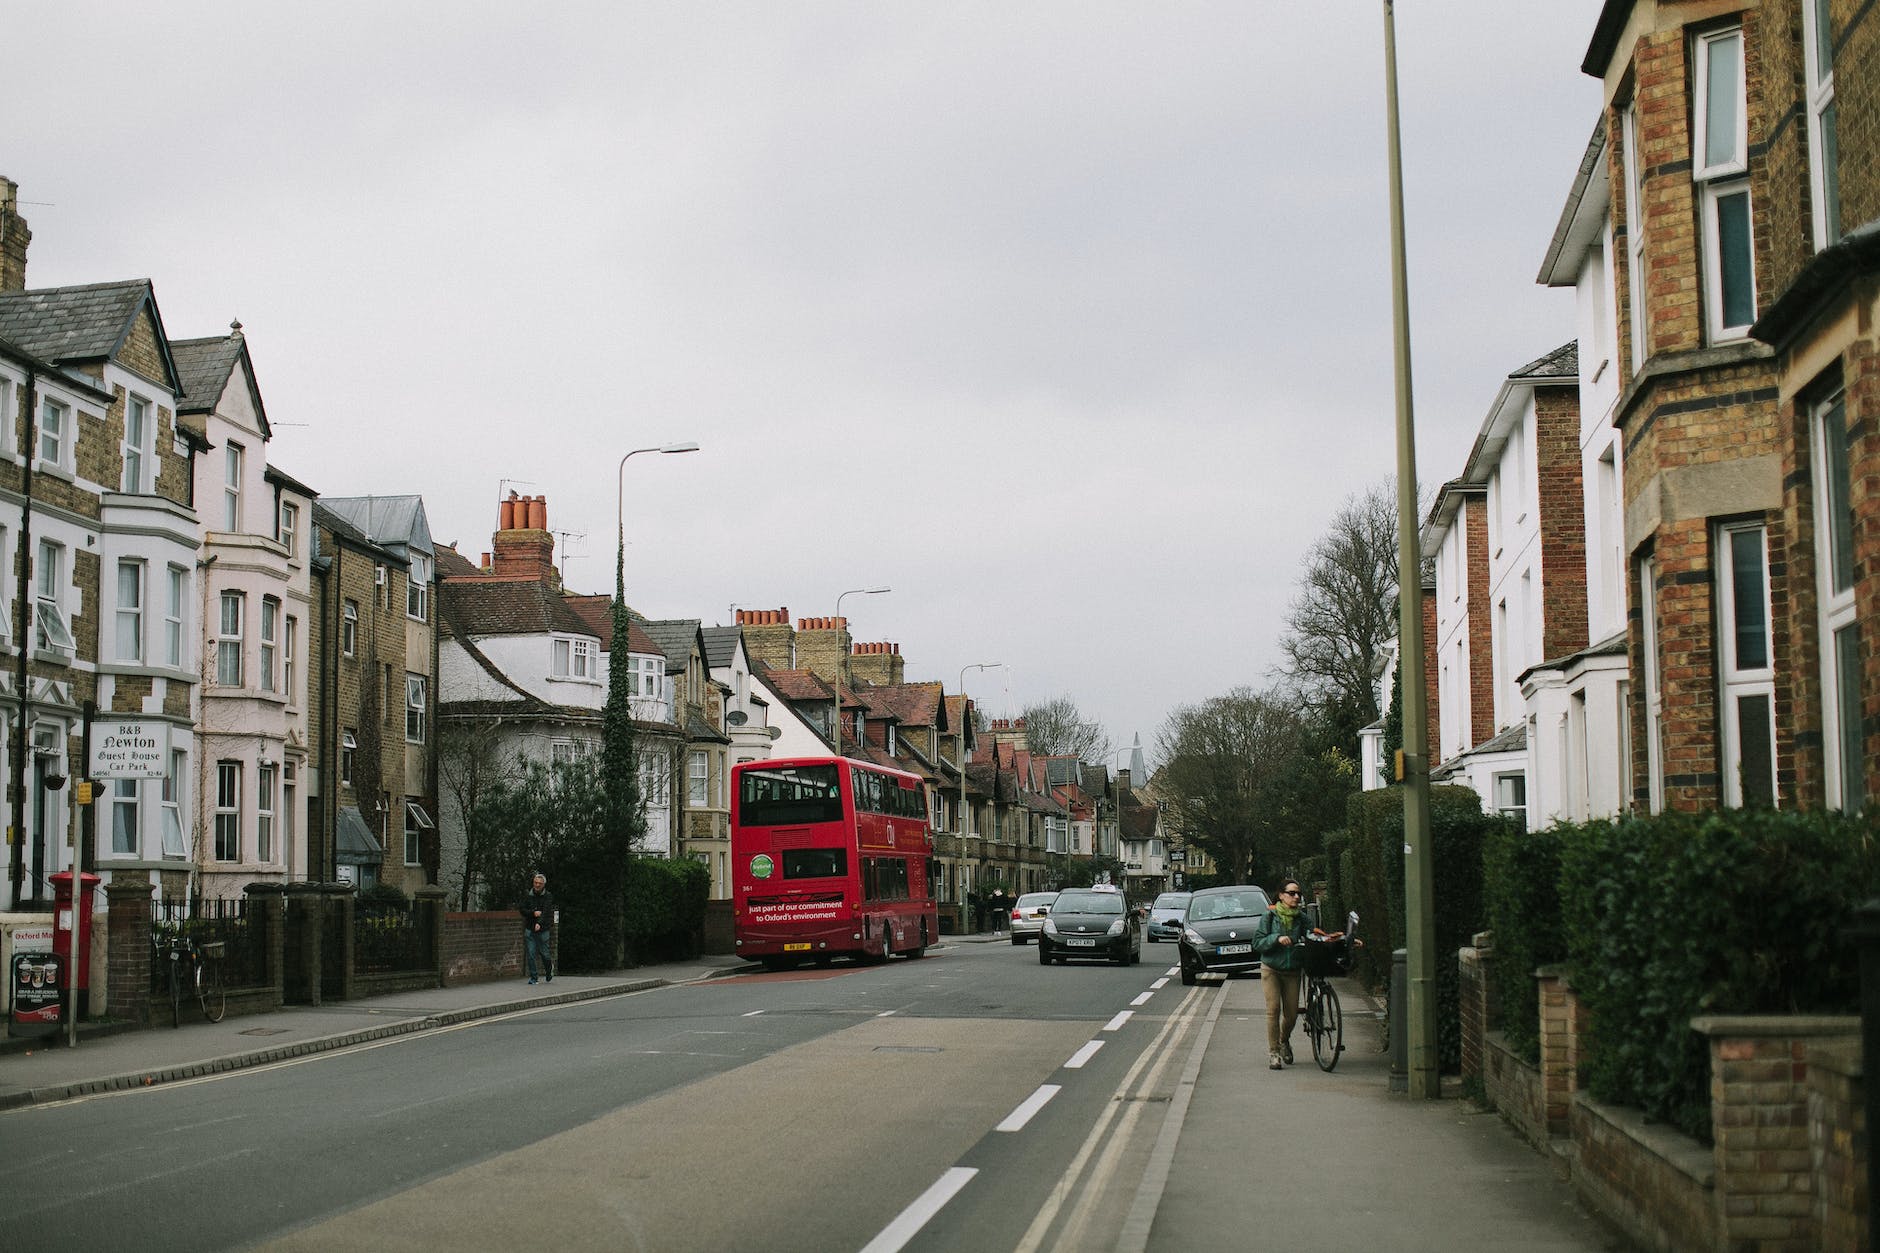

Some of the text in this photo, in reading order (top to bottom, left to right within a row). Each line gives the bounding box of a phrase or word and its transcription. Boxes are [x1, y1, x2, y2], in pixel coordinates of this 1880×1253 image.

[119, 725, 141, 735] B&B
[103, 736, 155, 748] Newton
[98, 751, 160, 760] Guest House
[109, 762, 148, 770] Car Park
[749, 905, 761, 914] just
[762, 905, 776, 913] part
[777, 903, 785, 911] of
[798, 902, 842, 910] commitment
[764, 913, 792, 922] Oxford's
[792, 911, 837, 920] environment
